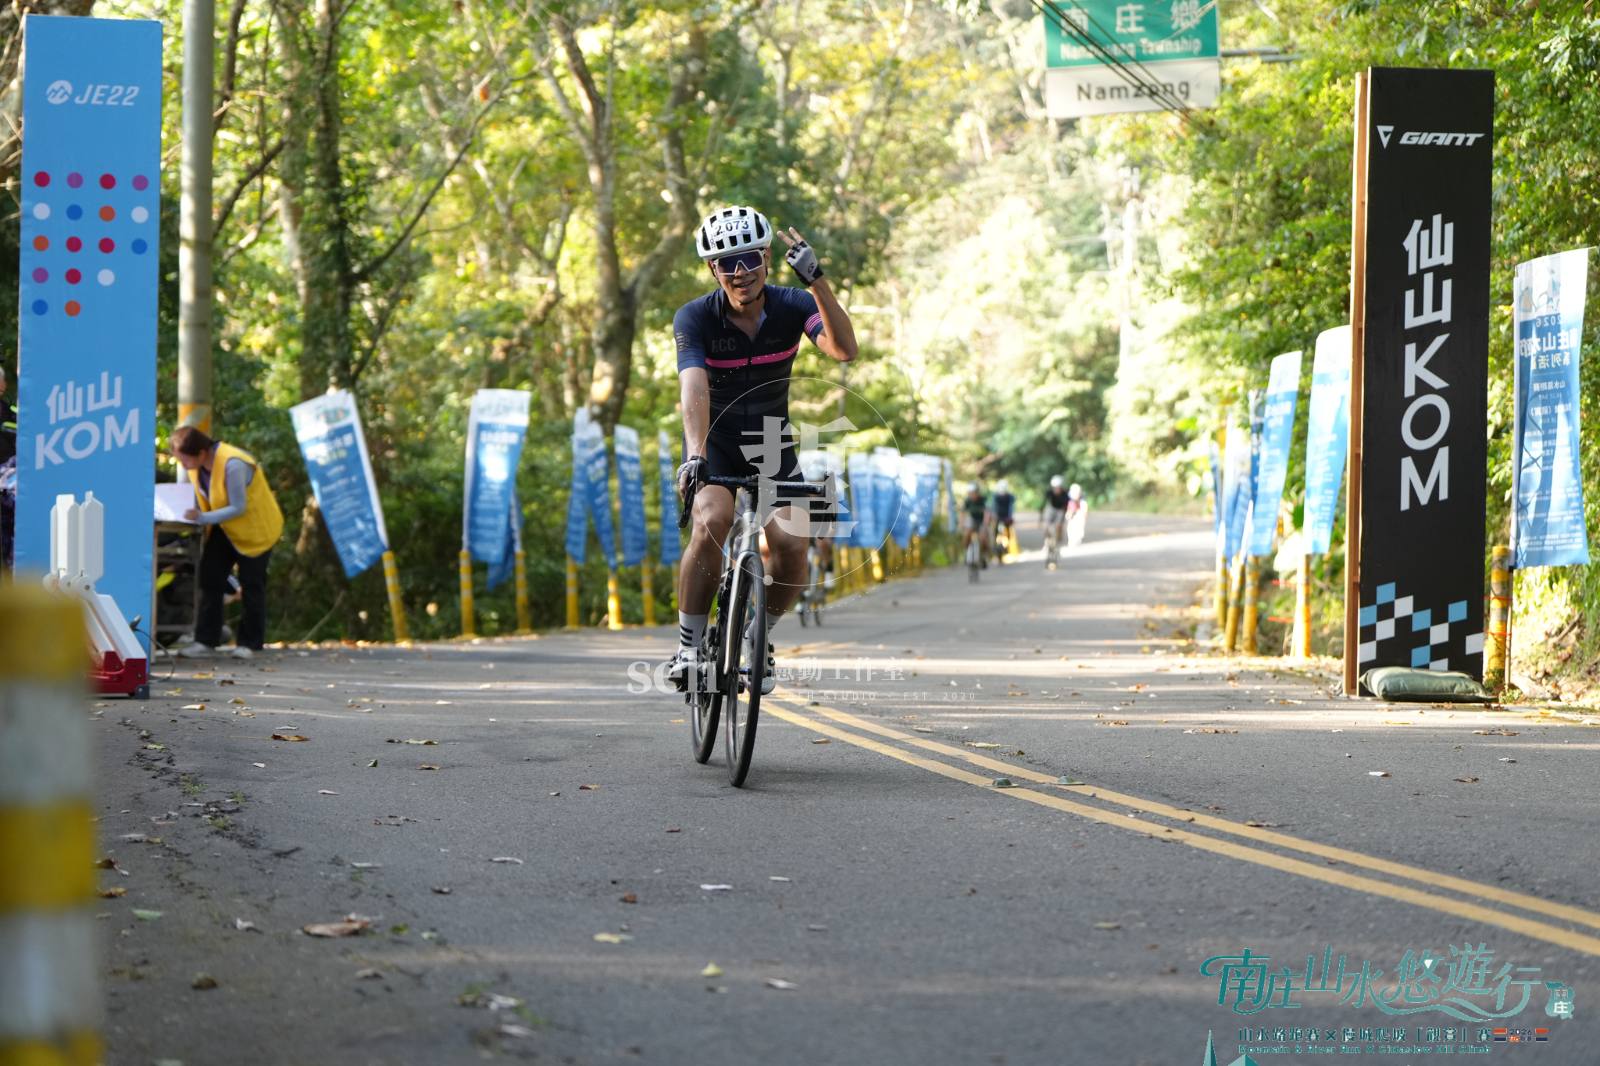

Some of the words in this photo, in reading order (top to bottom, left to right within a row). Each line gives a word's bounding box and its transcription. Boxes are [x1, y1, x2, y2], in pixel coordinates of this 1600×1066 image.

[74, 84, 140, 107] JE22
[1399, 131, 1486, 146] GIANT
[1403, 213, 1454, 330] 仙山
[46, 371, 123, 425] 仙山
[1400, 333, 1450, 511] KOM
[35, 408, 140, 470] KOM
